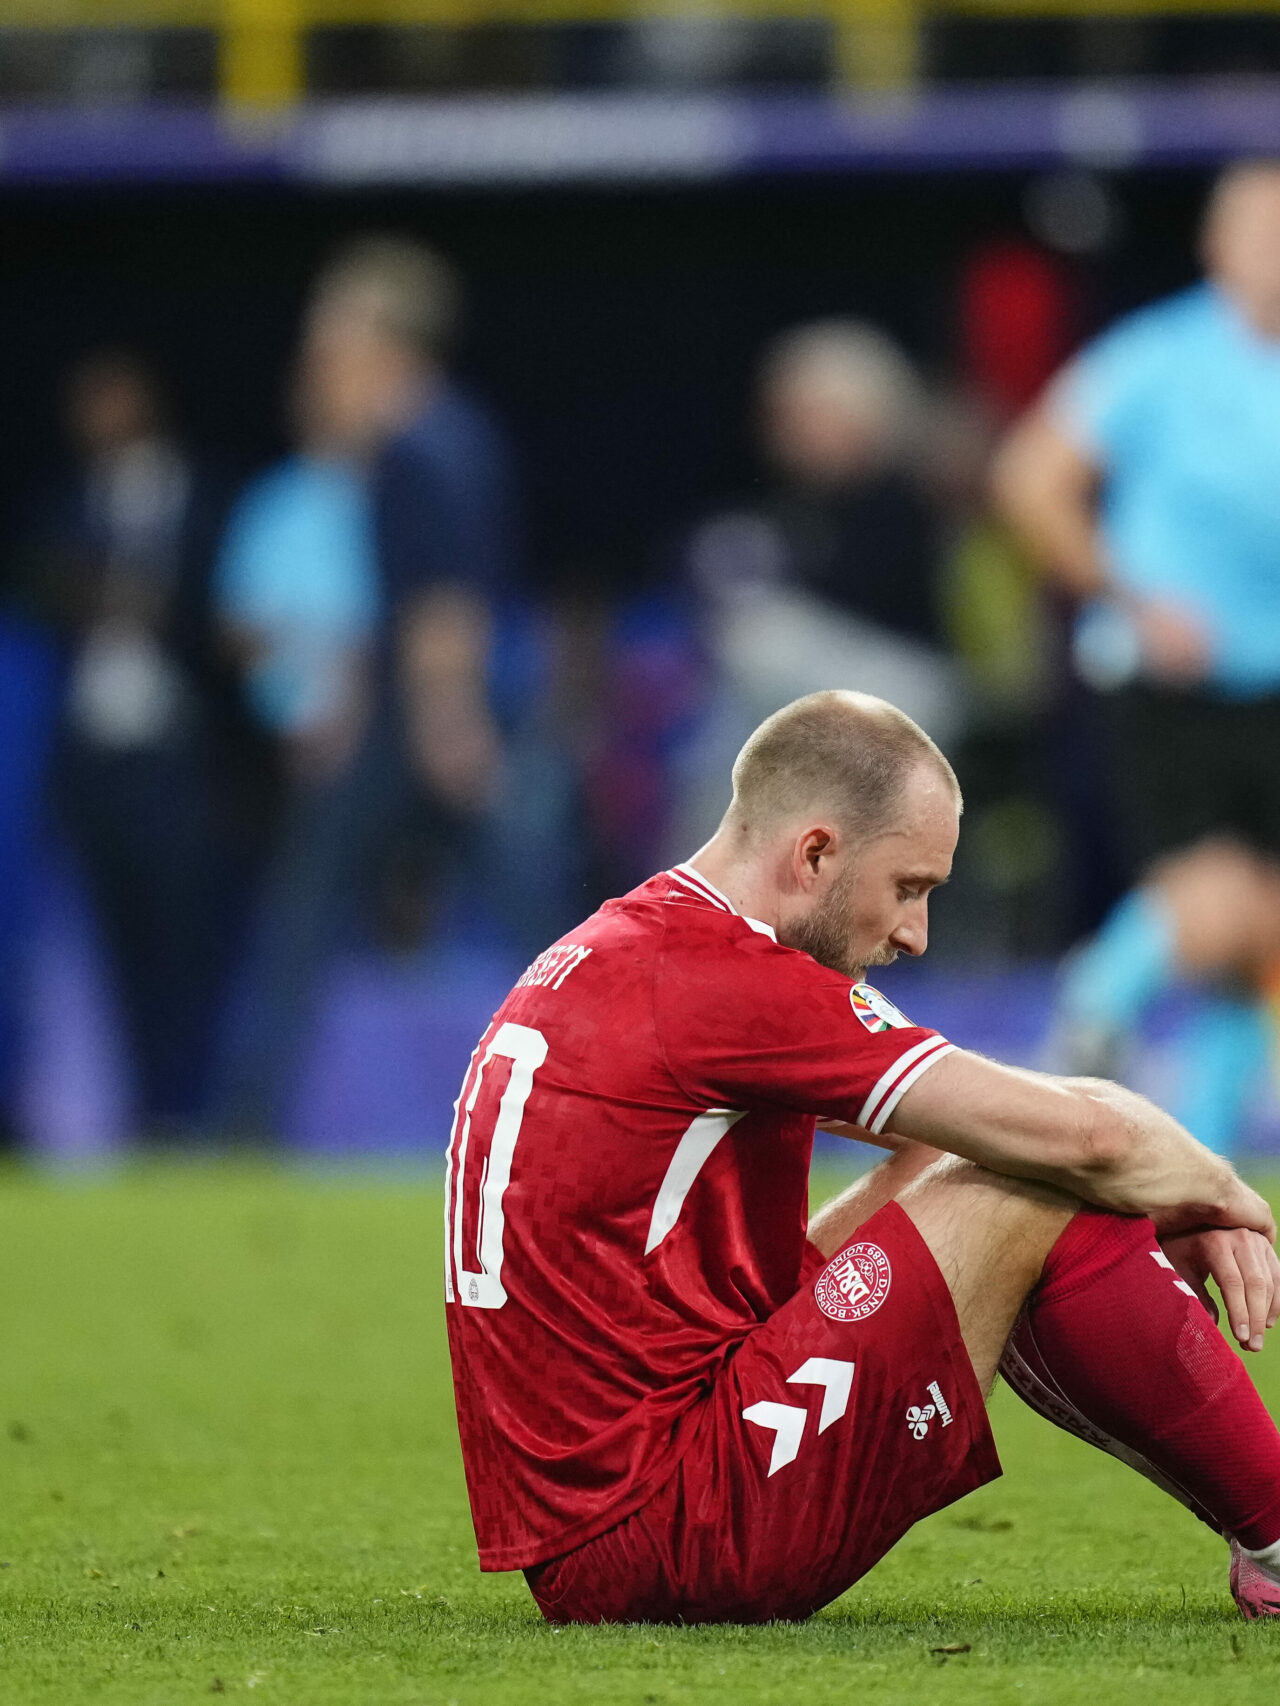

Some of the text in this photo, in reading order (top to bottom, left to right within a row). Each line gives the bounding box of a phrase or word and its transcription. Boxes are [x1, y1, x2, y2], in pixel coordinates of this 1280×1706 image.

[833, 1259, 870, 1305] DBU
[851, 1278, 888, 1318] DANSK
[926, 1380, 953, 1427] hummel
